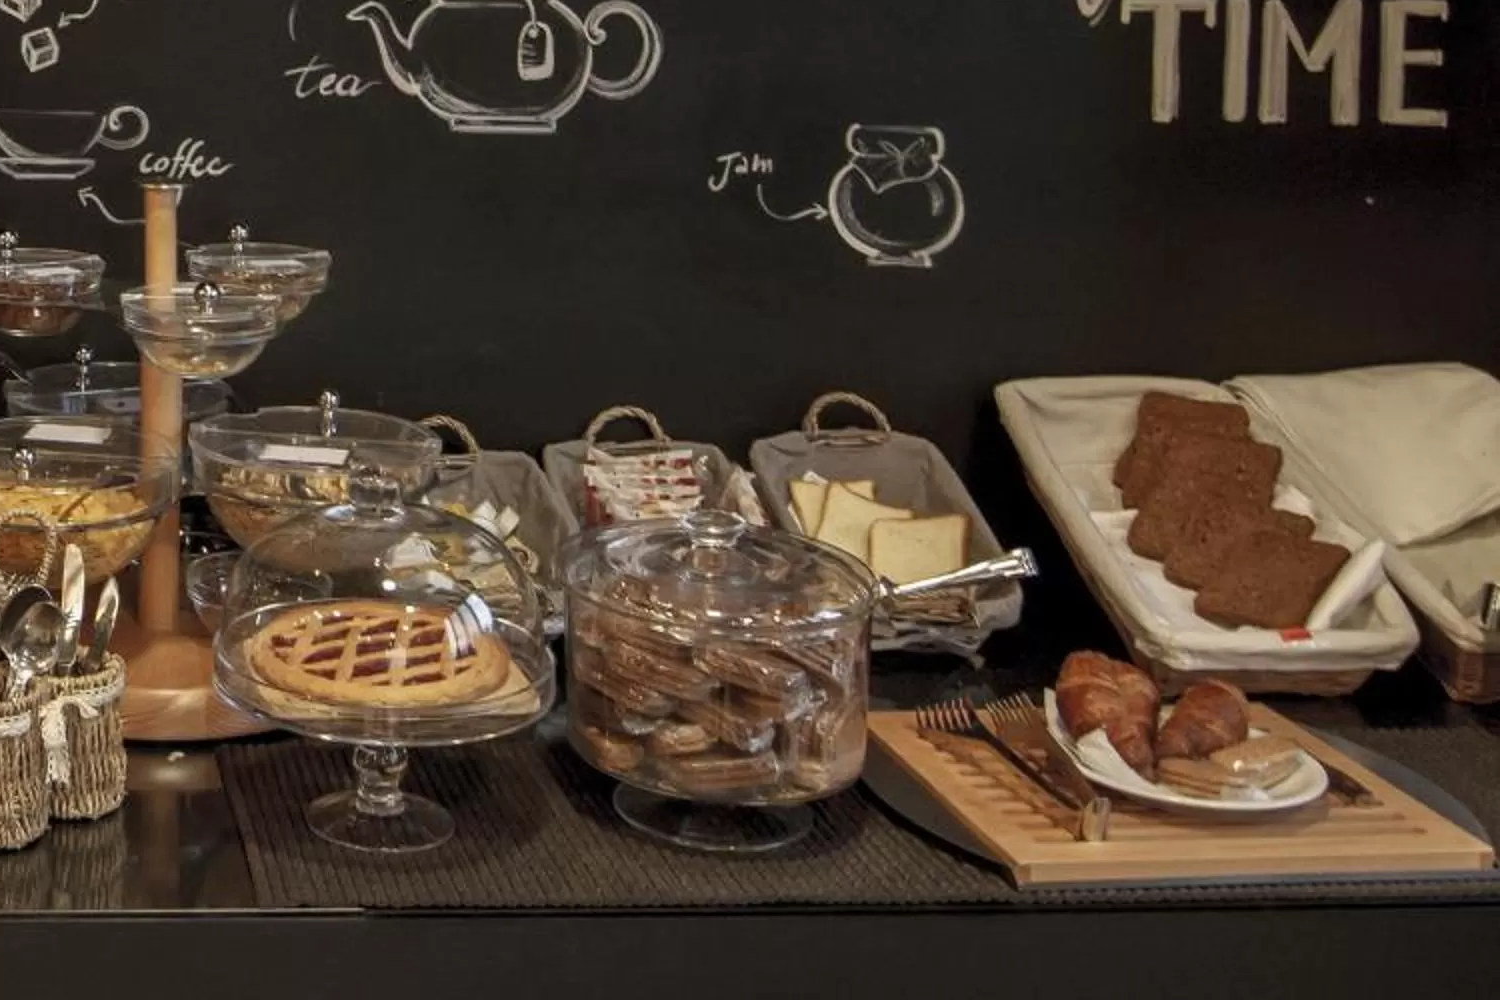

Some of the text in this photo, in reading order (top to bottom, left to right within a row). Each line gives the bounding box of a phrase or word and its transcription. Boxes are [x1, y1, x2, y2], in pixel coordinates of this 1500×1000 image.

[285, 55, 381, 99] tea
[139, 138, 233, 178] coffee
[708, 151, 774, 191] Jam
